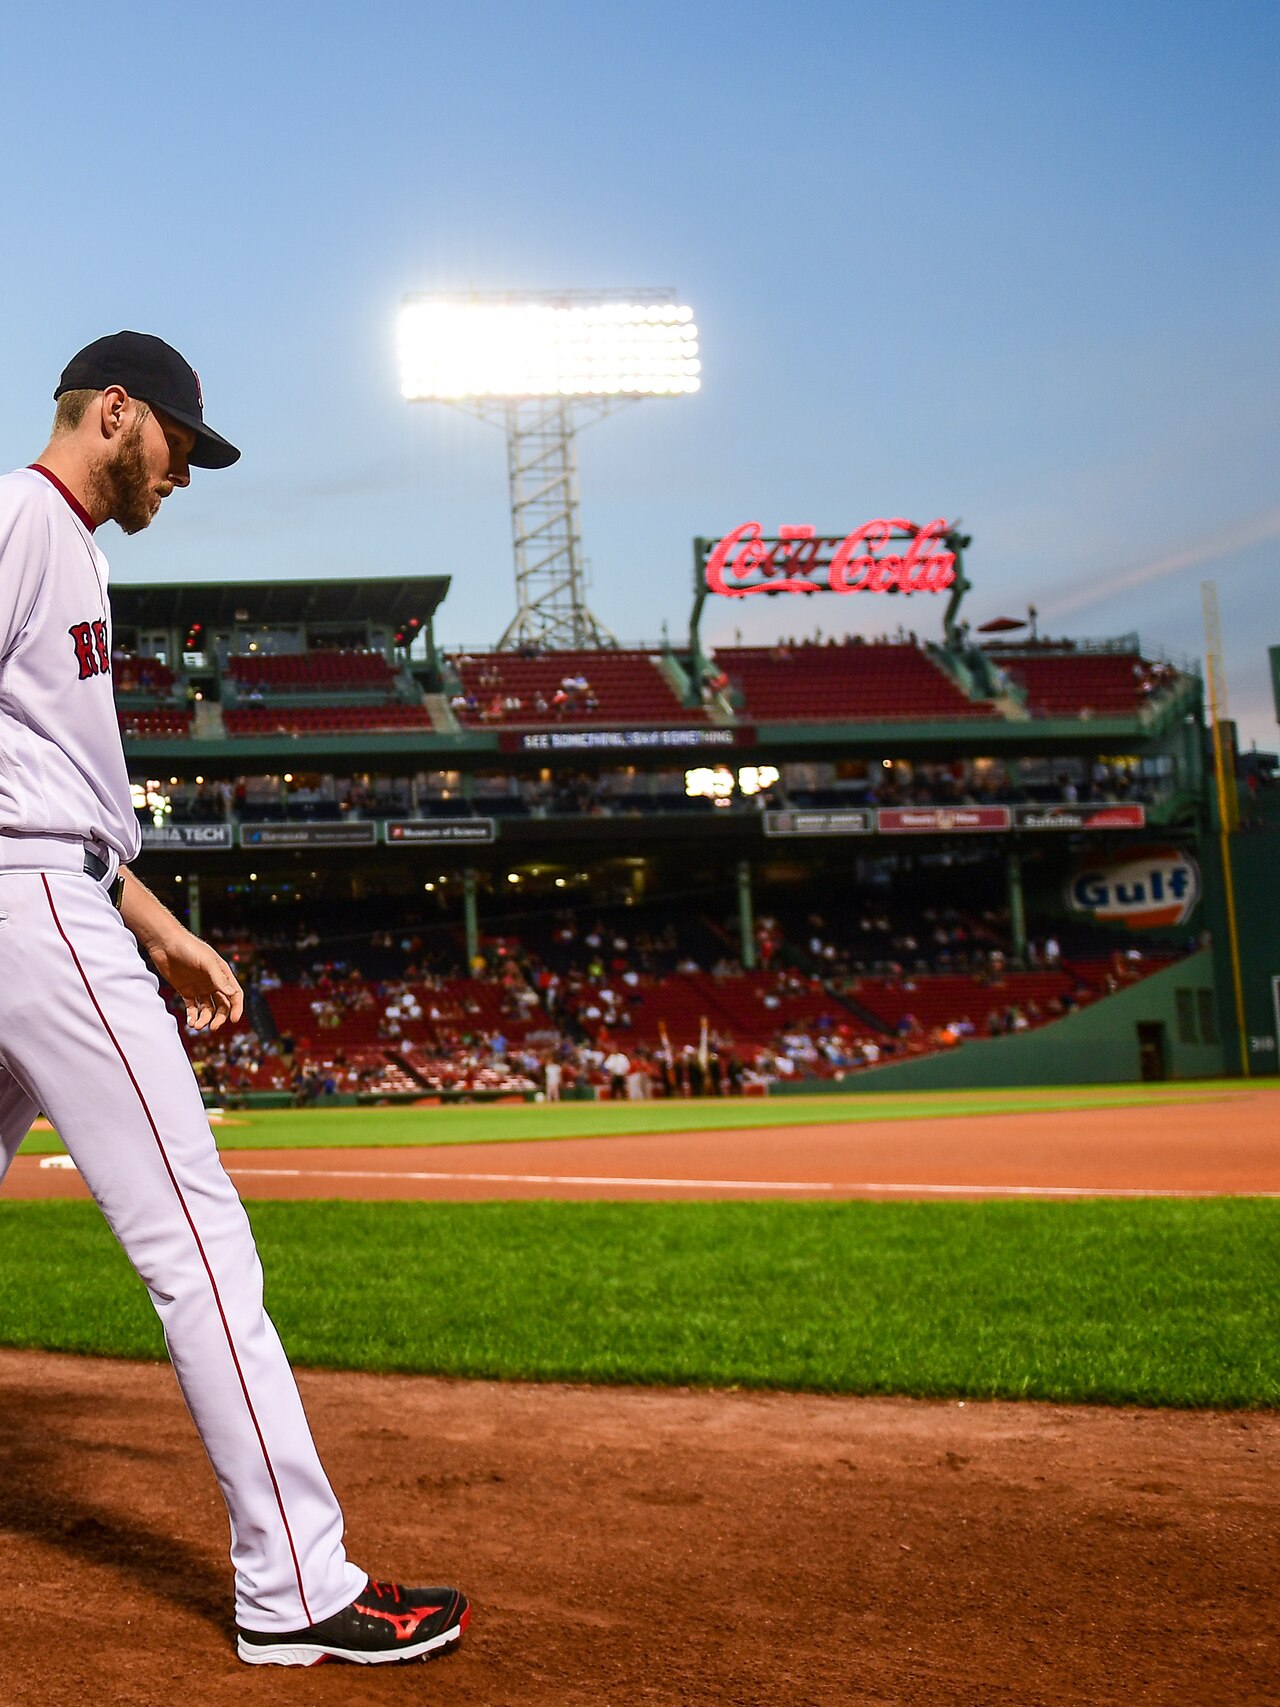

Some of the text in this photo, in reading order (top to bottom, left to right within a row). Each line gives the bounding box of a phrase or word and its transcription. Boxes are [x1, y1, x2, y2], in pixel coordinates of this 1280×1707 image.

[524, 734, 550, 749] SEE
[184, 828, 225, 841] TECH
[1074, 869, 1188, 908] Gulf
